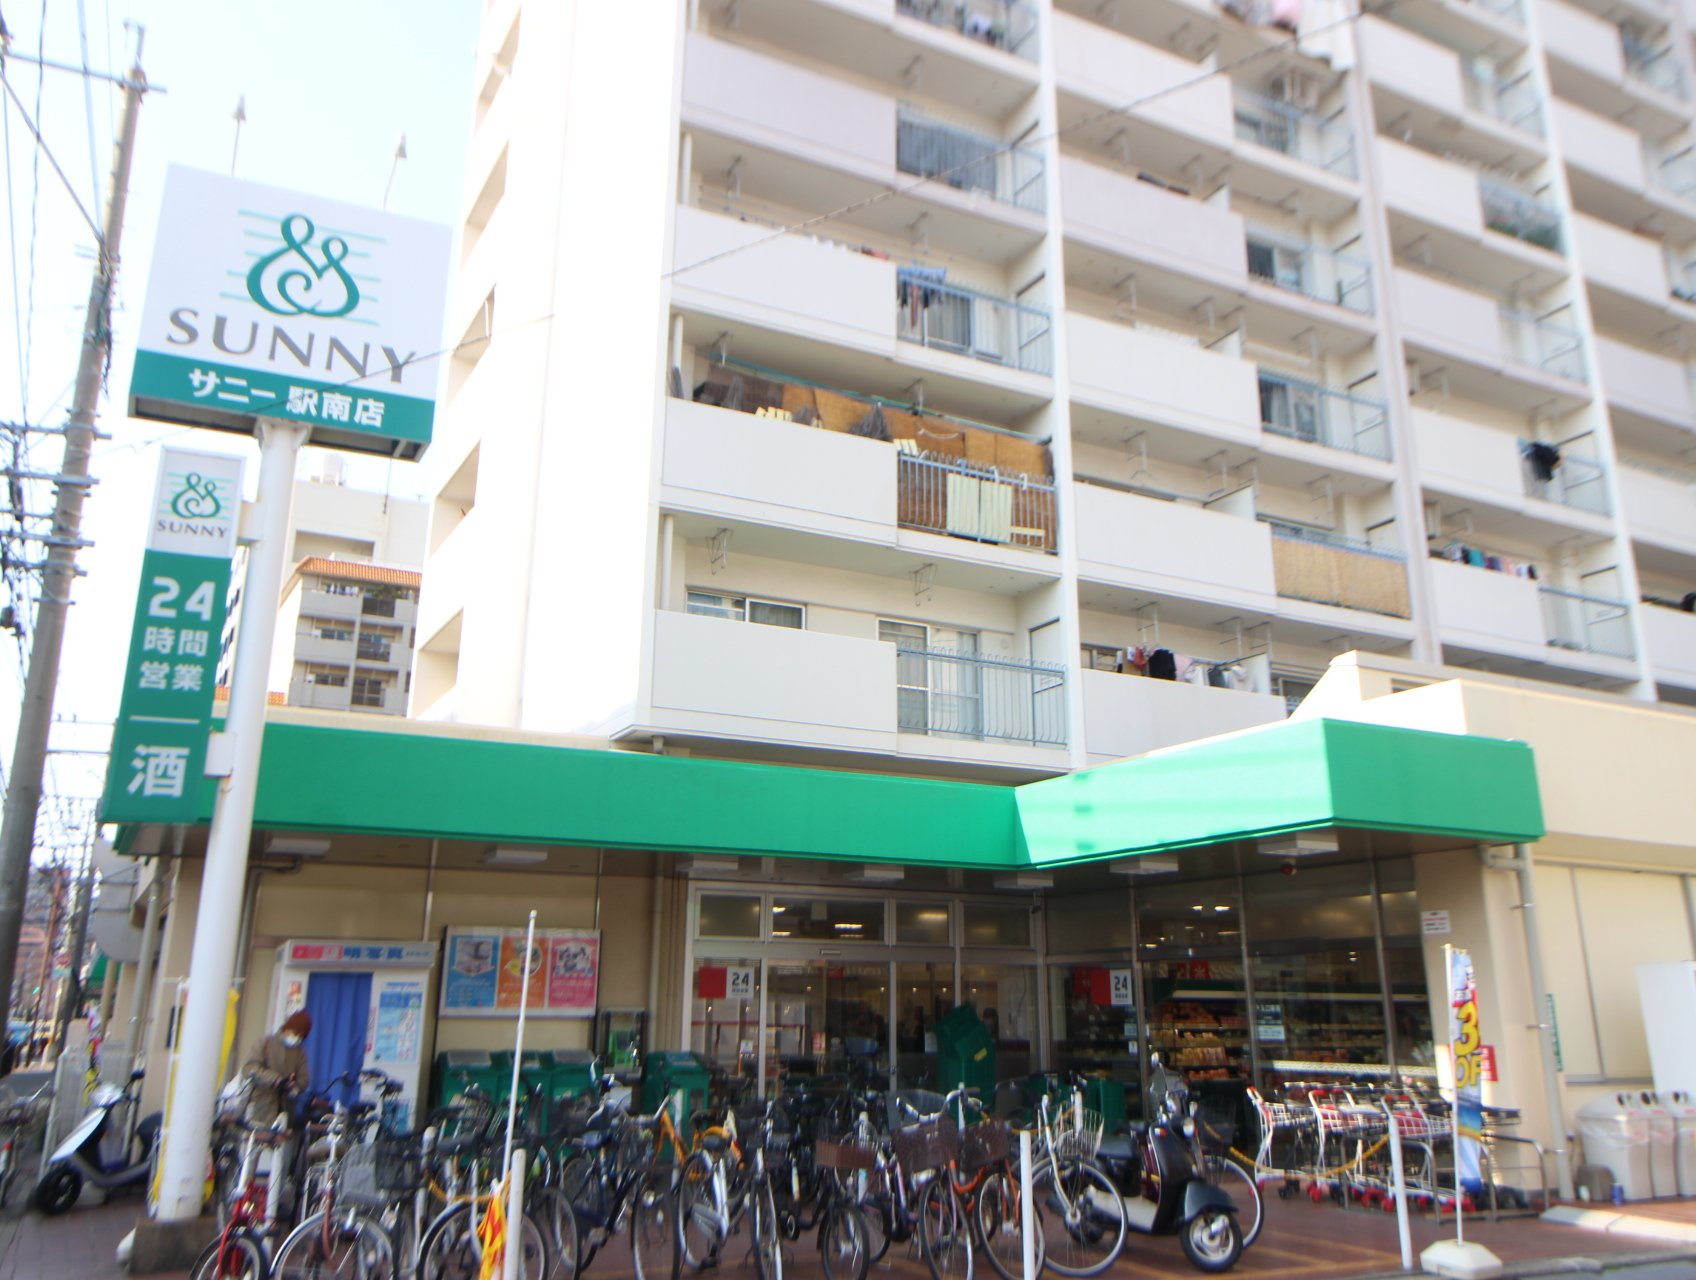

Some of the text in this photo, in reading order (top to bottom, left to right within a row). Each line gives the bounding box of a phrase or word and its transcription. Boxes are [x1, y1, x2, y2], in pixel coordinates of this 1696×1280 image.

[166, 307, 415, 383] SUNNY
[188, 368, 385, 428] サニー 駅南店
[157, 519, 228, 539] SUNNY
[148, 576, 216, 621] 24
[143, 626, 209, 657] 時間
[138, 661, 203, 692] 営業
[127, 744, 190, 798] 酒
[732, 972, 749, 986] 24
[1114, 975, 1128, 991] 24
